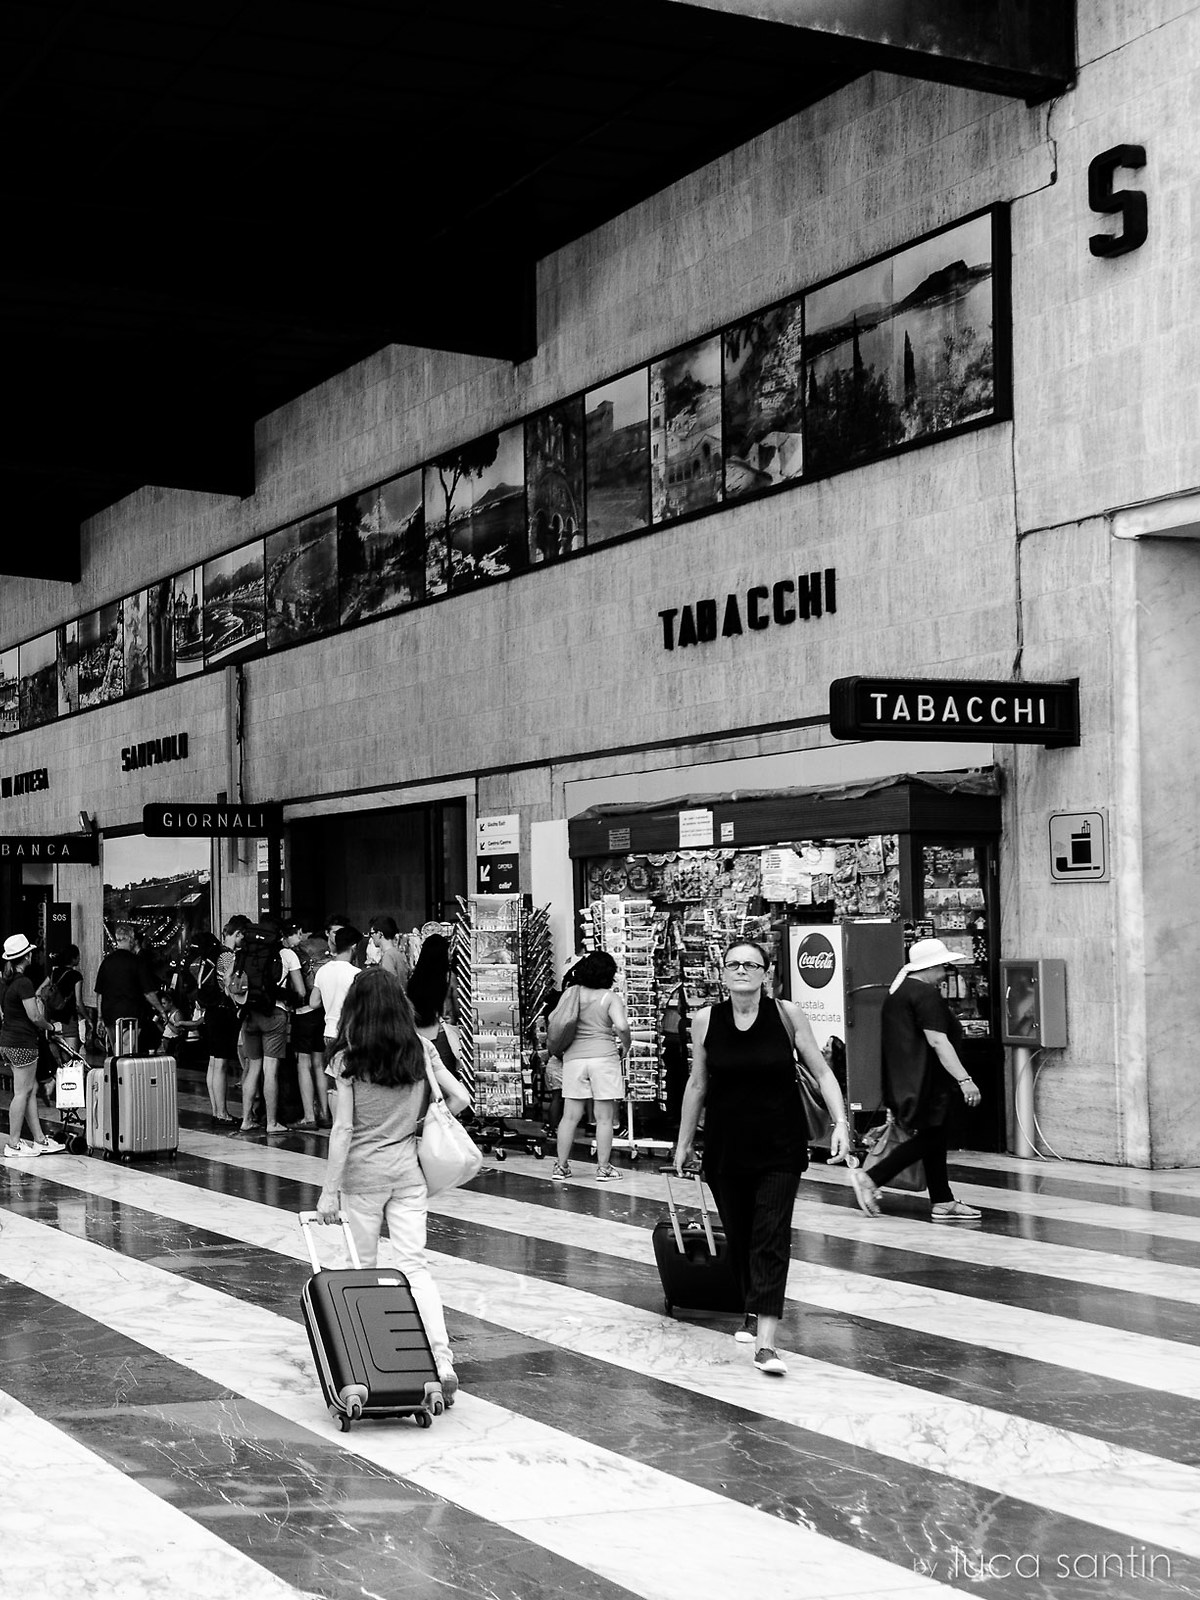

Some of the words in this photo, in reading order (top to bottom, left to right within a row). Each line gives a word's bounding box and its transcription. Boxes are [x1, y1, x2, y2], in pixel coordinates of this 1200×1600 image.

[1088, 144, 1148, 259] S
[658, 569, 837, 650] TABACCHI
[870, 693, 1045, 724] TABACCHI
[163, 812, 264, 828] GIORNALI
[1, 843, 70, 856] BANCA
[52, 913, 67, 922] SOS
[799, 951, 834, 969] Coca-Cola
[804, 1012, 841, 1022] hiacciata
